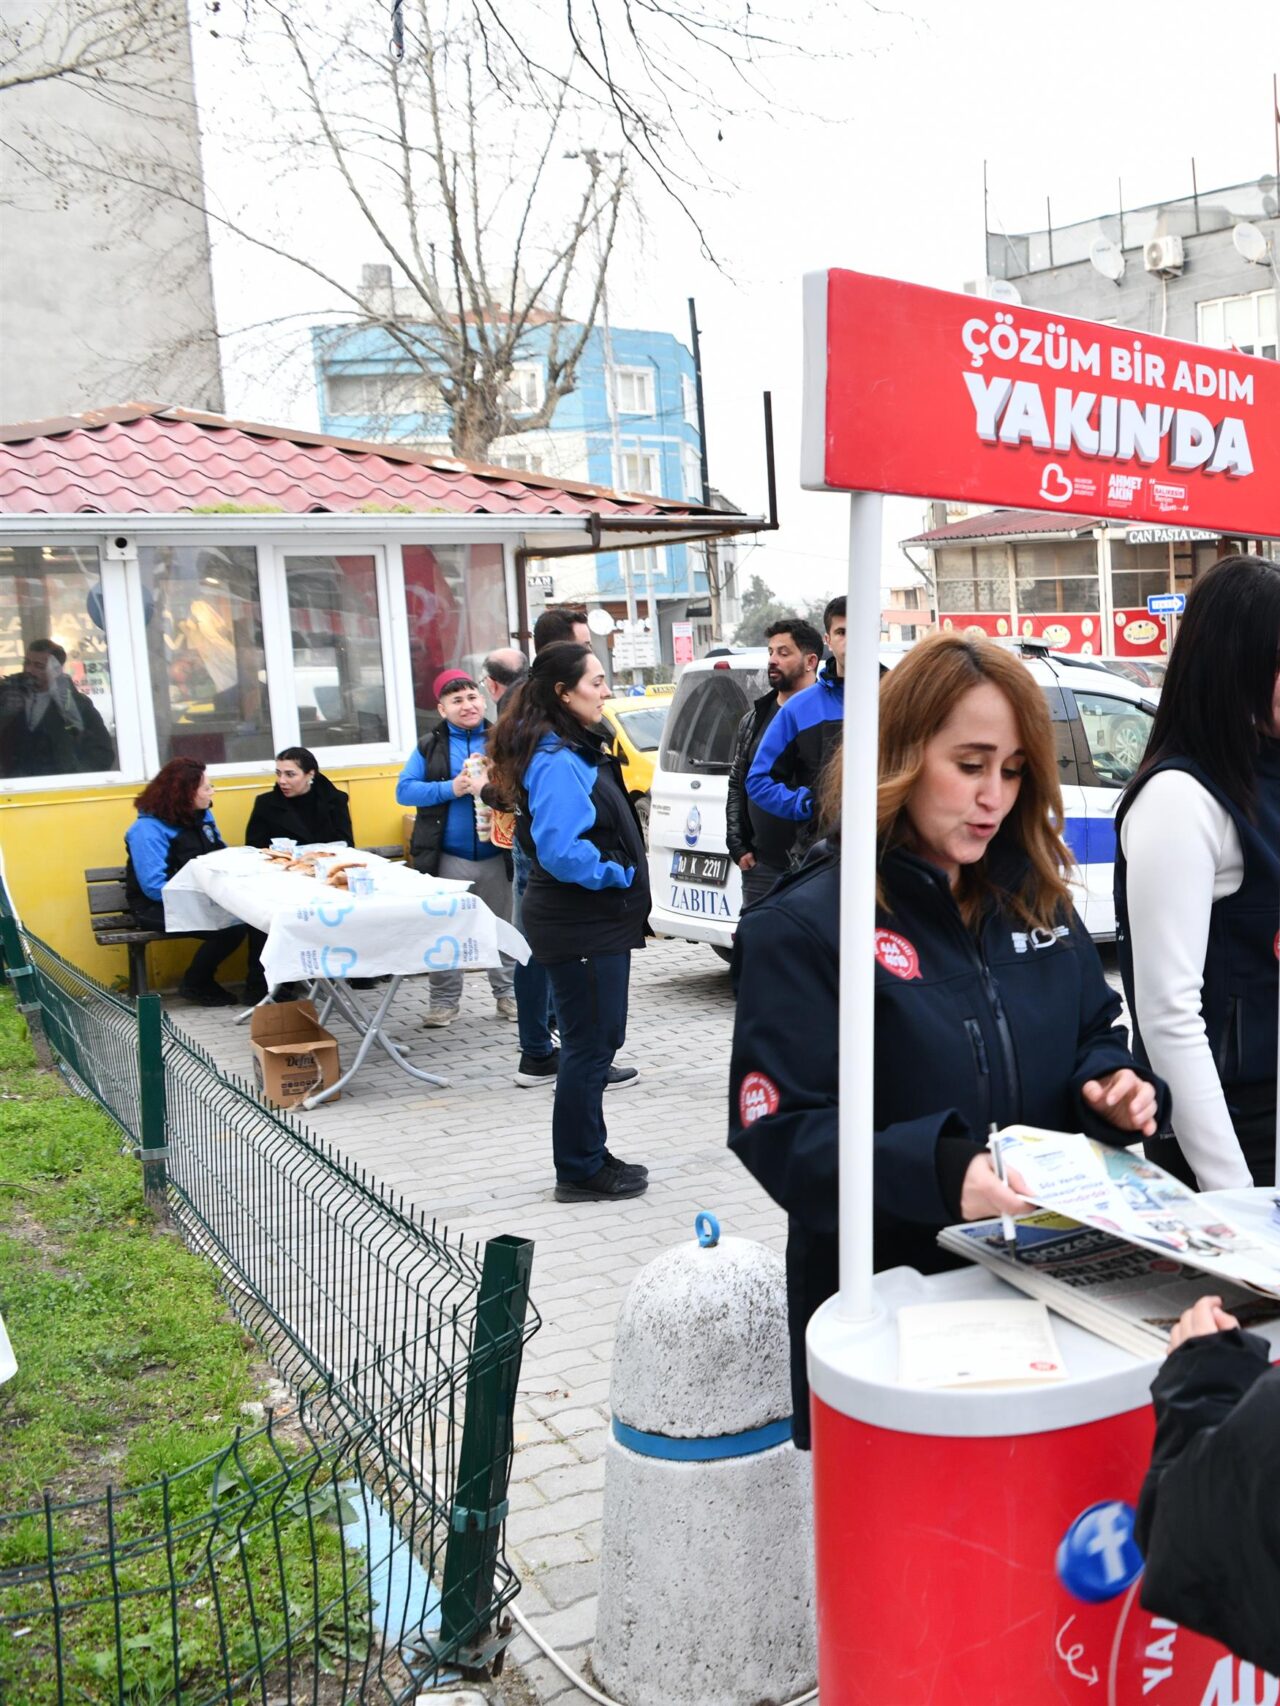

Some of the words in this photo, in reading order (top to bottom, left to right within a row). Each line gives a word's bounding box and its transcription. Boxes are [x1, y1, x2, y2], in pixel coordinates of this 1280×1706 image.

[961, 312, 1100, 377] ÇÖZÜM
[1111, 340, 1165, 389] BİR
[1173, 360, 1254, 405] ADIM
[962, 371, 1254, 478] YAKIN'DA
[1108, 474, 1143, 491] AHMET
[1108, 486, 1134, 501] AKIN
[1129, 530, 1152, 543] CAN
[1154, 528, 1188, 542] PASTA
[690, 857, 698, 875] K
[702, 858, 722, 878] 2211
[671, 885, 732, 917] ZABITA
